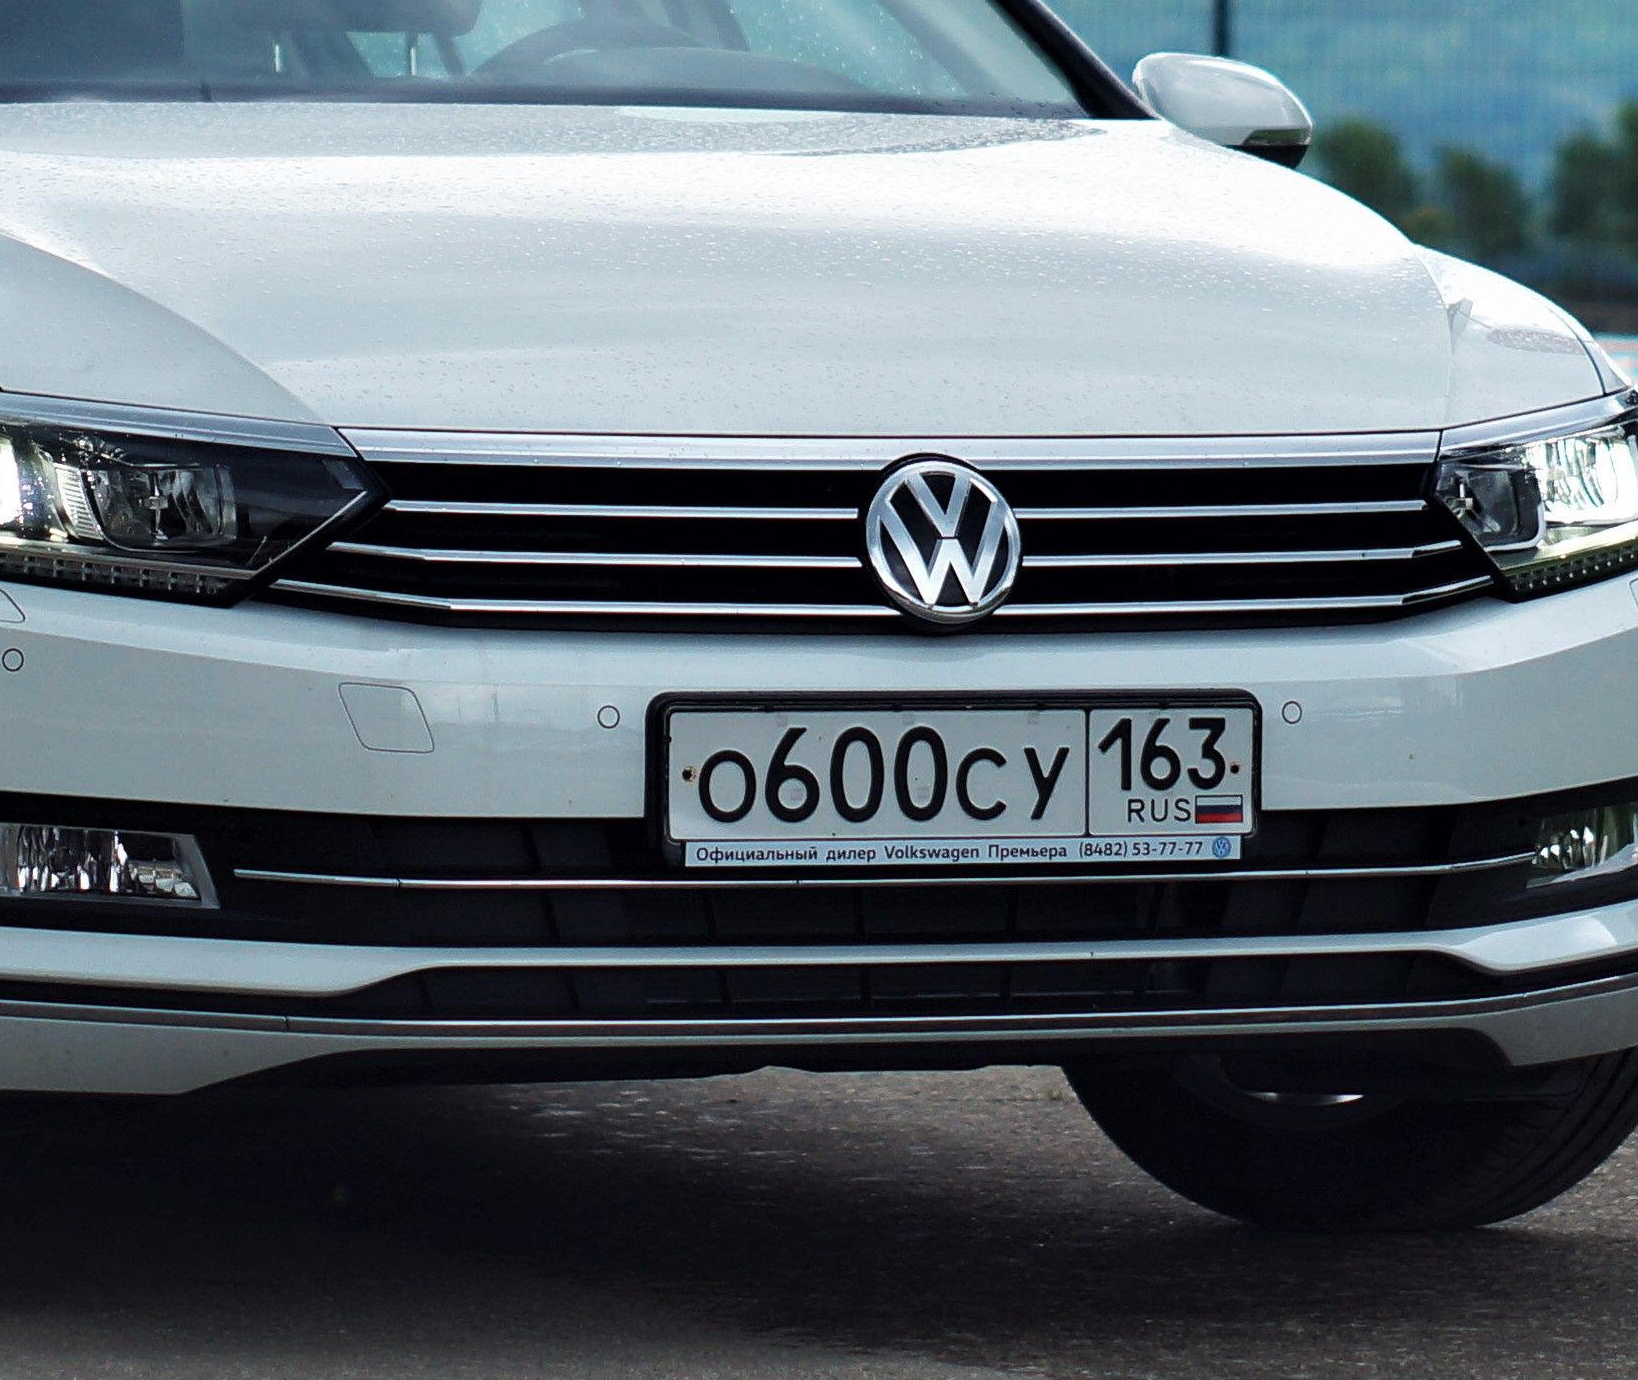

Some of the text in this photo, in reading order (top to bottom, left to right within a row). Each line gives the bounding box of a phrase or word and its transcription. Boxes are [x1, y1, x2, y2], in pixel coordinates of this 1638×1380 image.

[870, 462, 1016, 618] VW
[1097, 716, 1227, 792] 163
[1127, 797, 1192, 823] RUS
[696, 846, 818, 864] Официальный
[825, 848, 876, 863] дилер
[884, 845, 980, 862] Volkswagen
[988, 844, 1067, 861] Премьера
[1079, 841, 1128, 858] (8482)
[1132, 841, 1203, 856] 53-77-77
